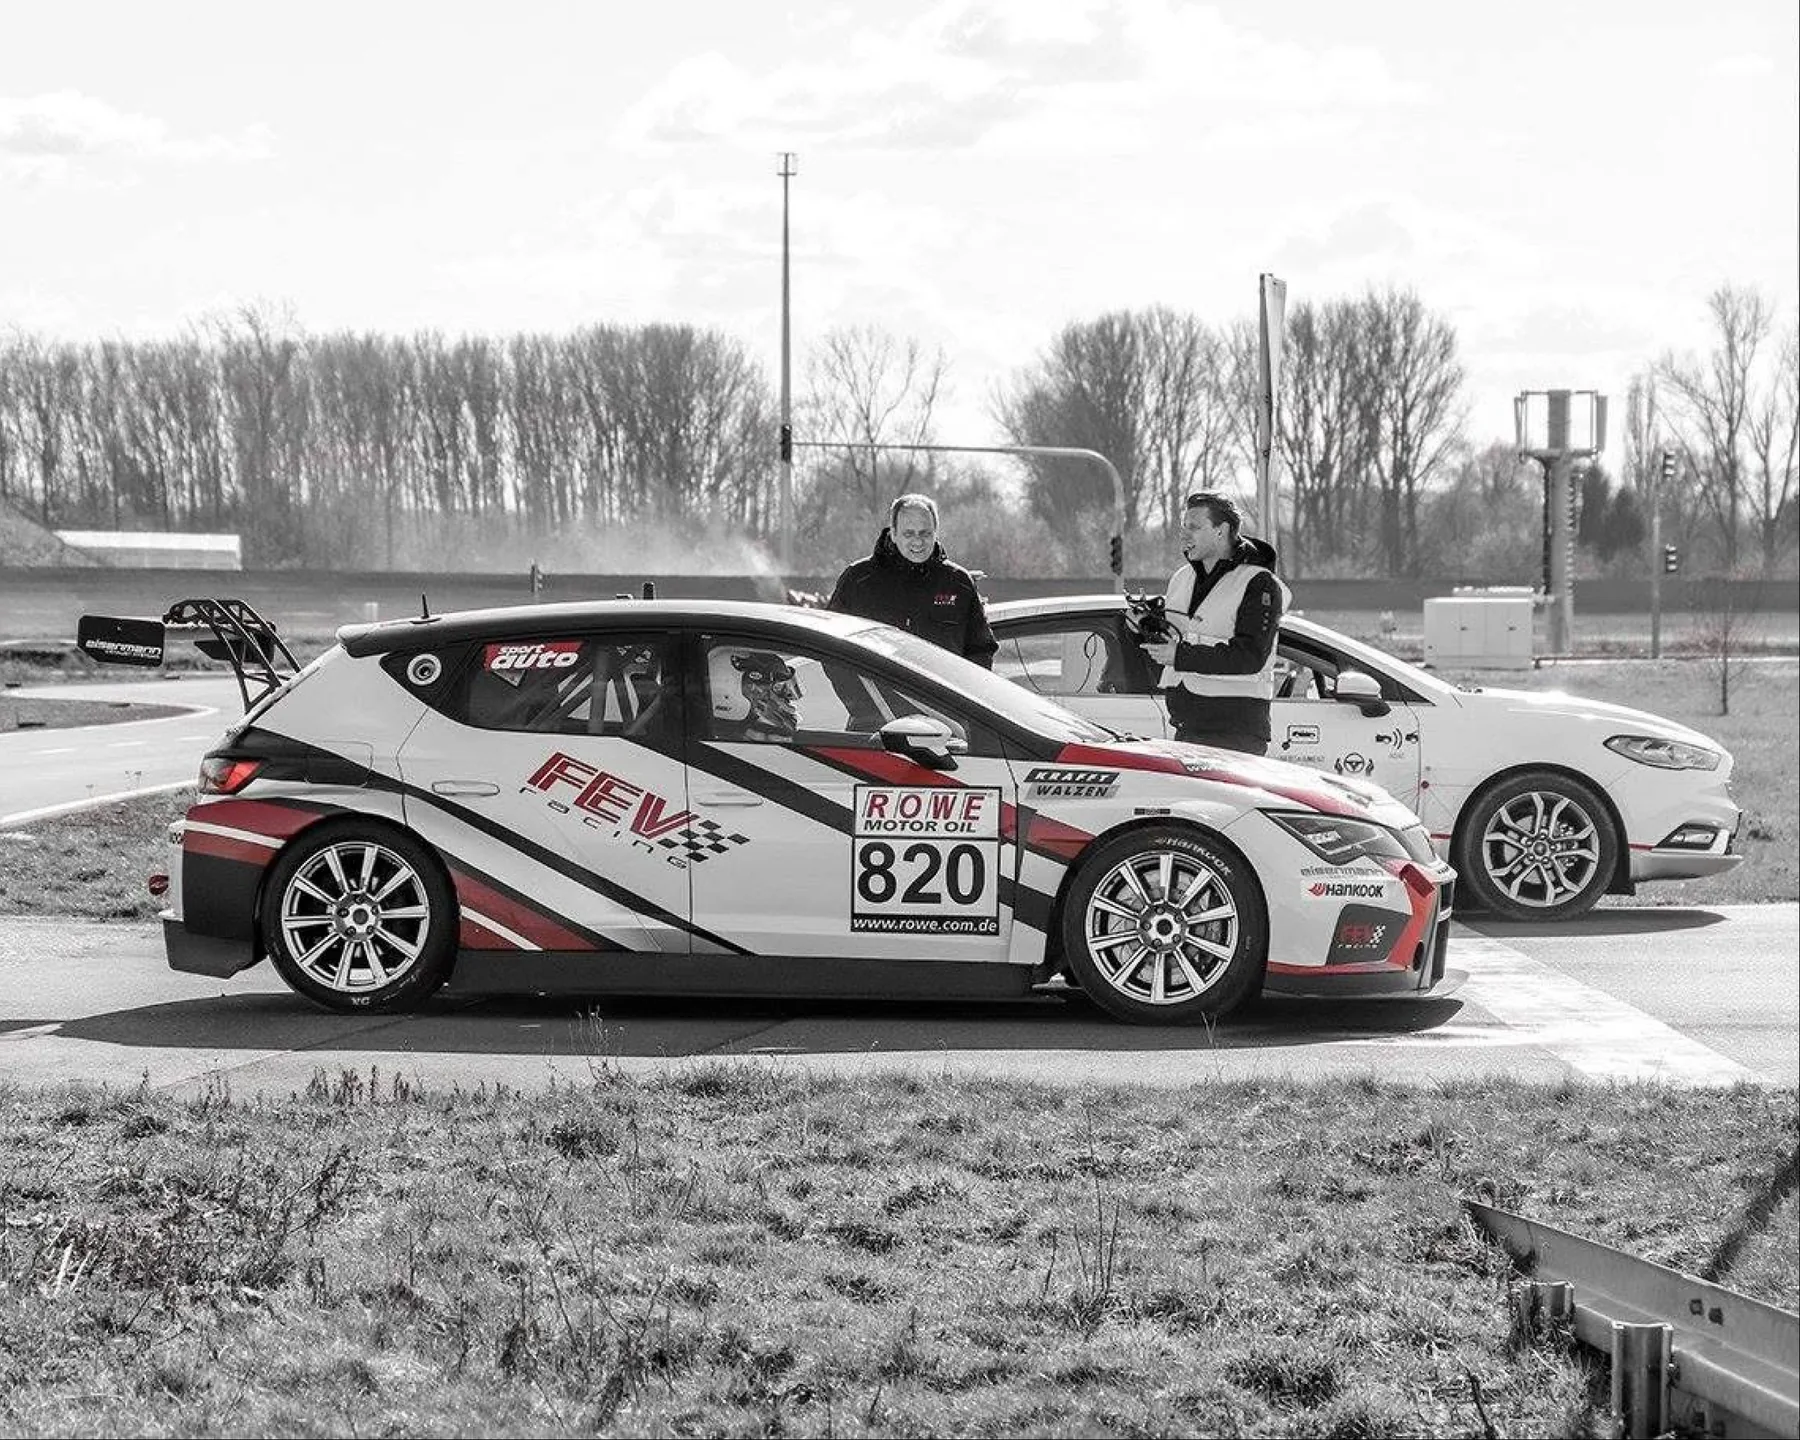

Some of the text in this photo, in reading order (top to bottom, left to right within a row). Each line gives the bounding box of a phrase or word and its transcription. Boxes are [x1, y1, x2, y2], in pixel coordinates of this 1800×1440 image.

[497, 644, 546, 656] sport
[490, 650, 579, 670] auto
[1034, 771, 1111, 783] KRAFFT
[526, 751, 701, 840] FEV
[1036, 785, 1109, 798] WALZEN
[865, 792, 986, 821] ROWE
[518, 785, 688, 870] racing
[863, 819, 977, 833] MOTOR OIL
[857, 841, 986, 905] 820
[853, 918, 998, 933] www.rowe.com.de
